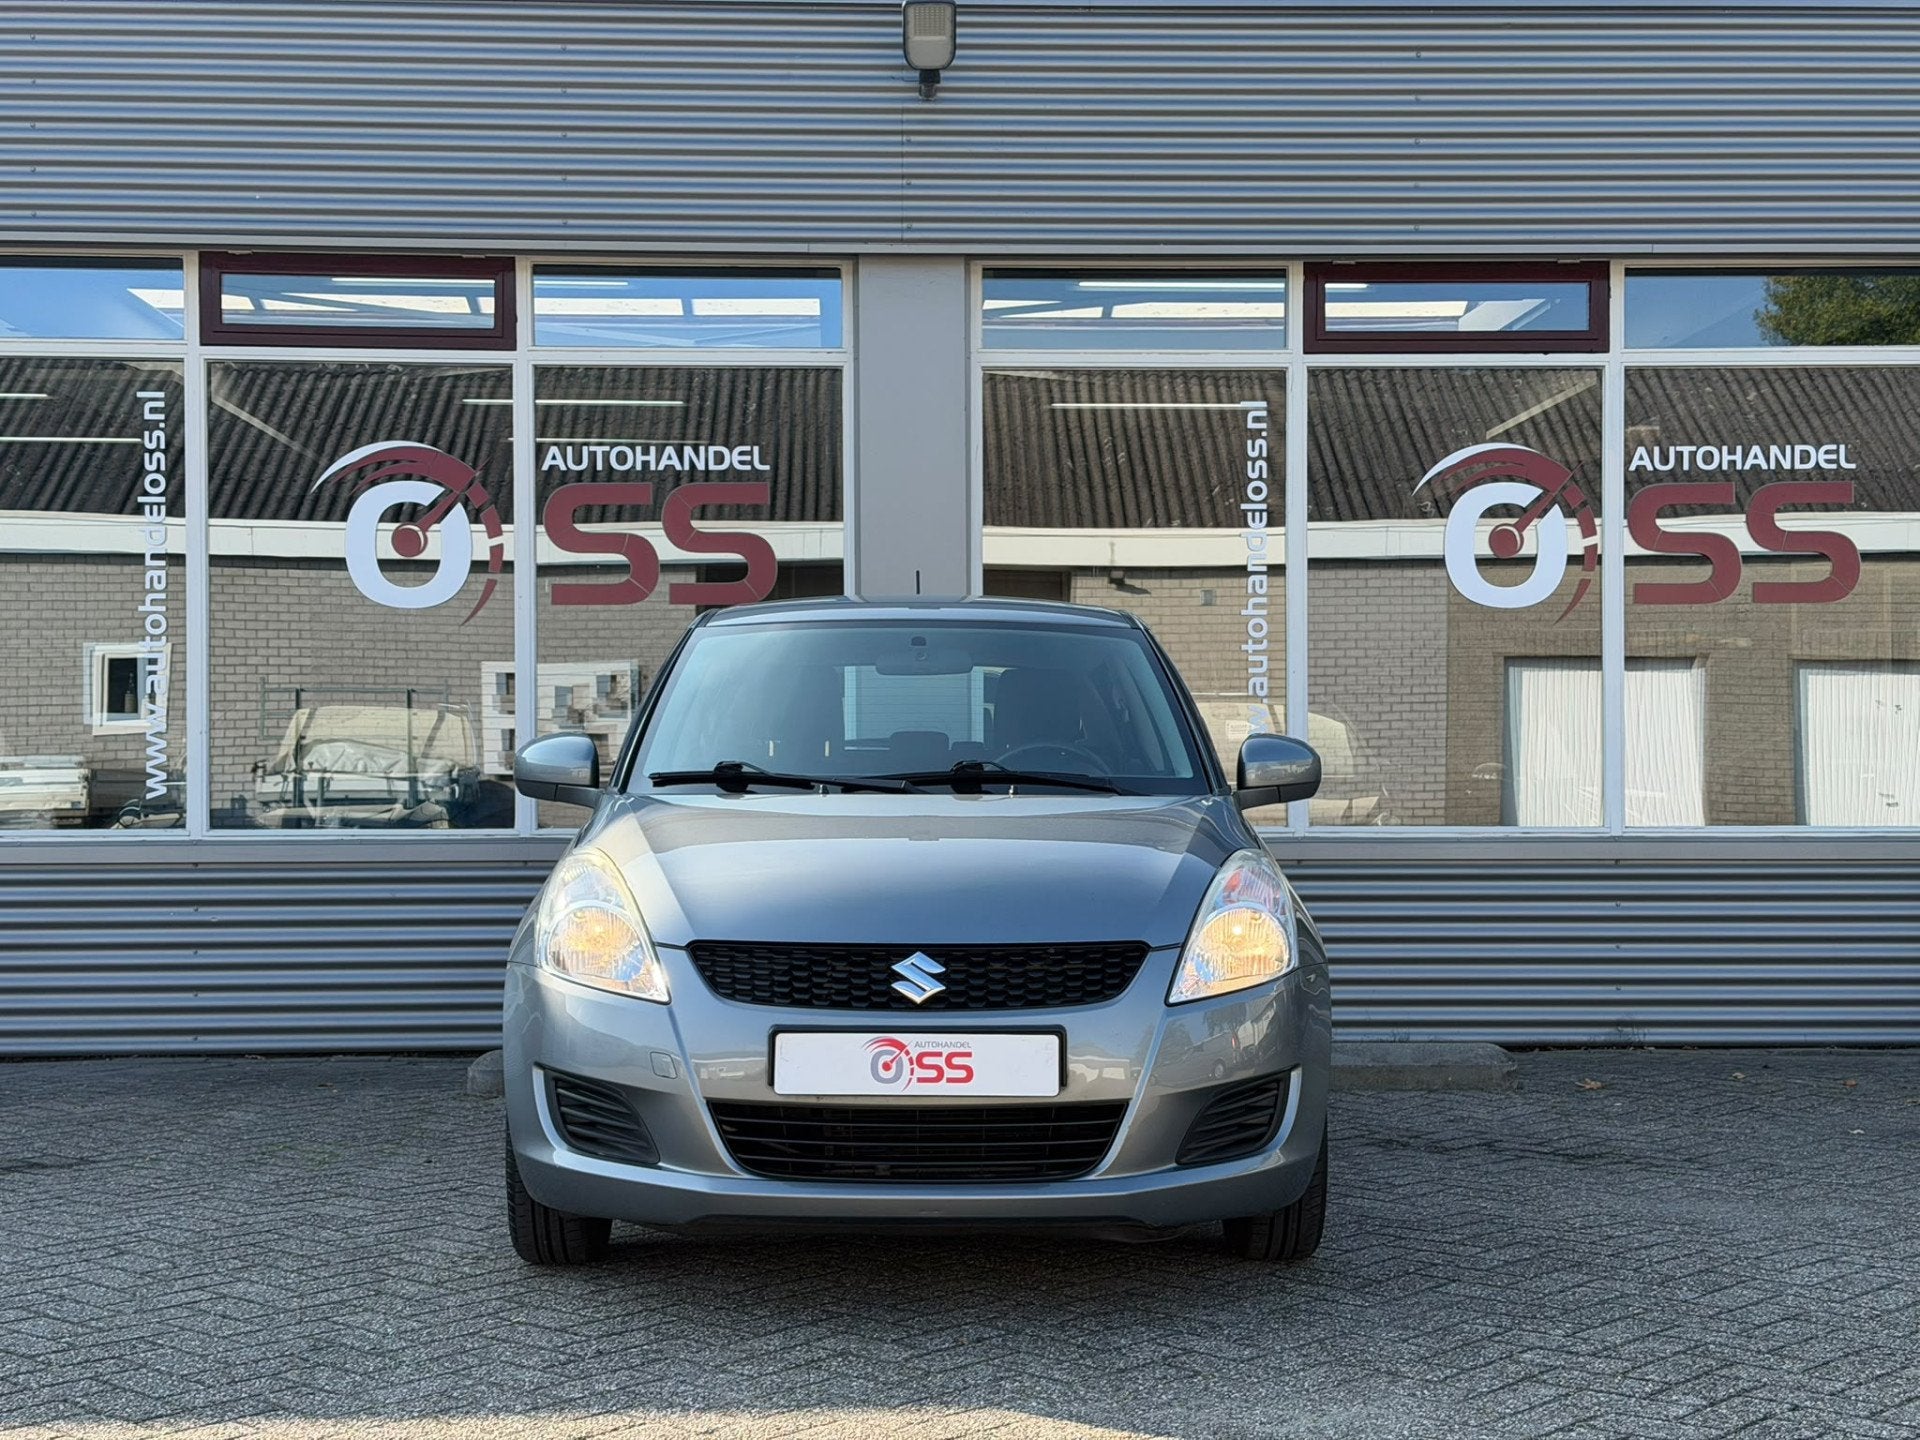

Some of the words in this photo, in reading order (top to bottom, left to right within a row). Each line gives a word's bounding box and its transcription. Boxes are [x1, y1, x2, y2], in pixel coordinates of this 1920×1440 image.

[541, 445, 770, 471] AUTOHANDEL
[1628, 444, 1857, 470] AUTOHANDEL
[345, 480, 777, 609] OSS
[1444, 481, 1861, 609] OSS
[136, 391, 168, 800] www.autohandeloss.nl
[914, 1041, 972, 1049] AUTOHANDEL
[870, 1049, 974, 1084] OSS
